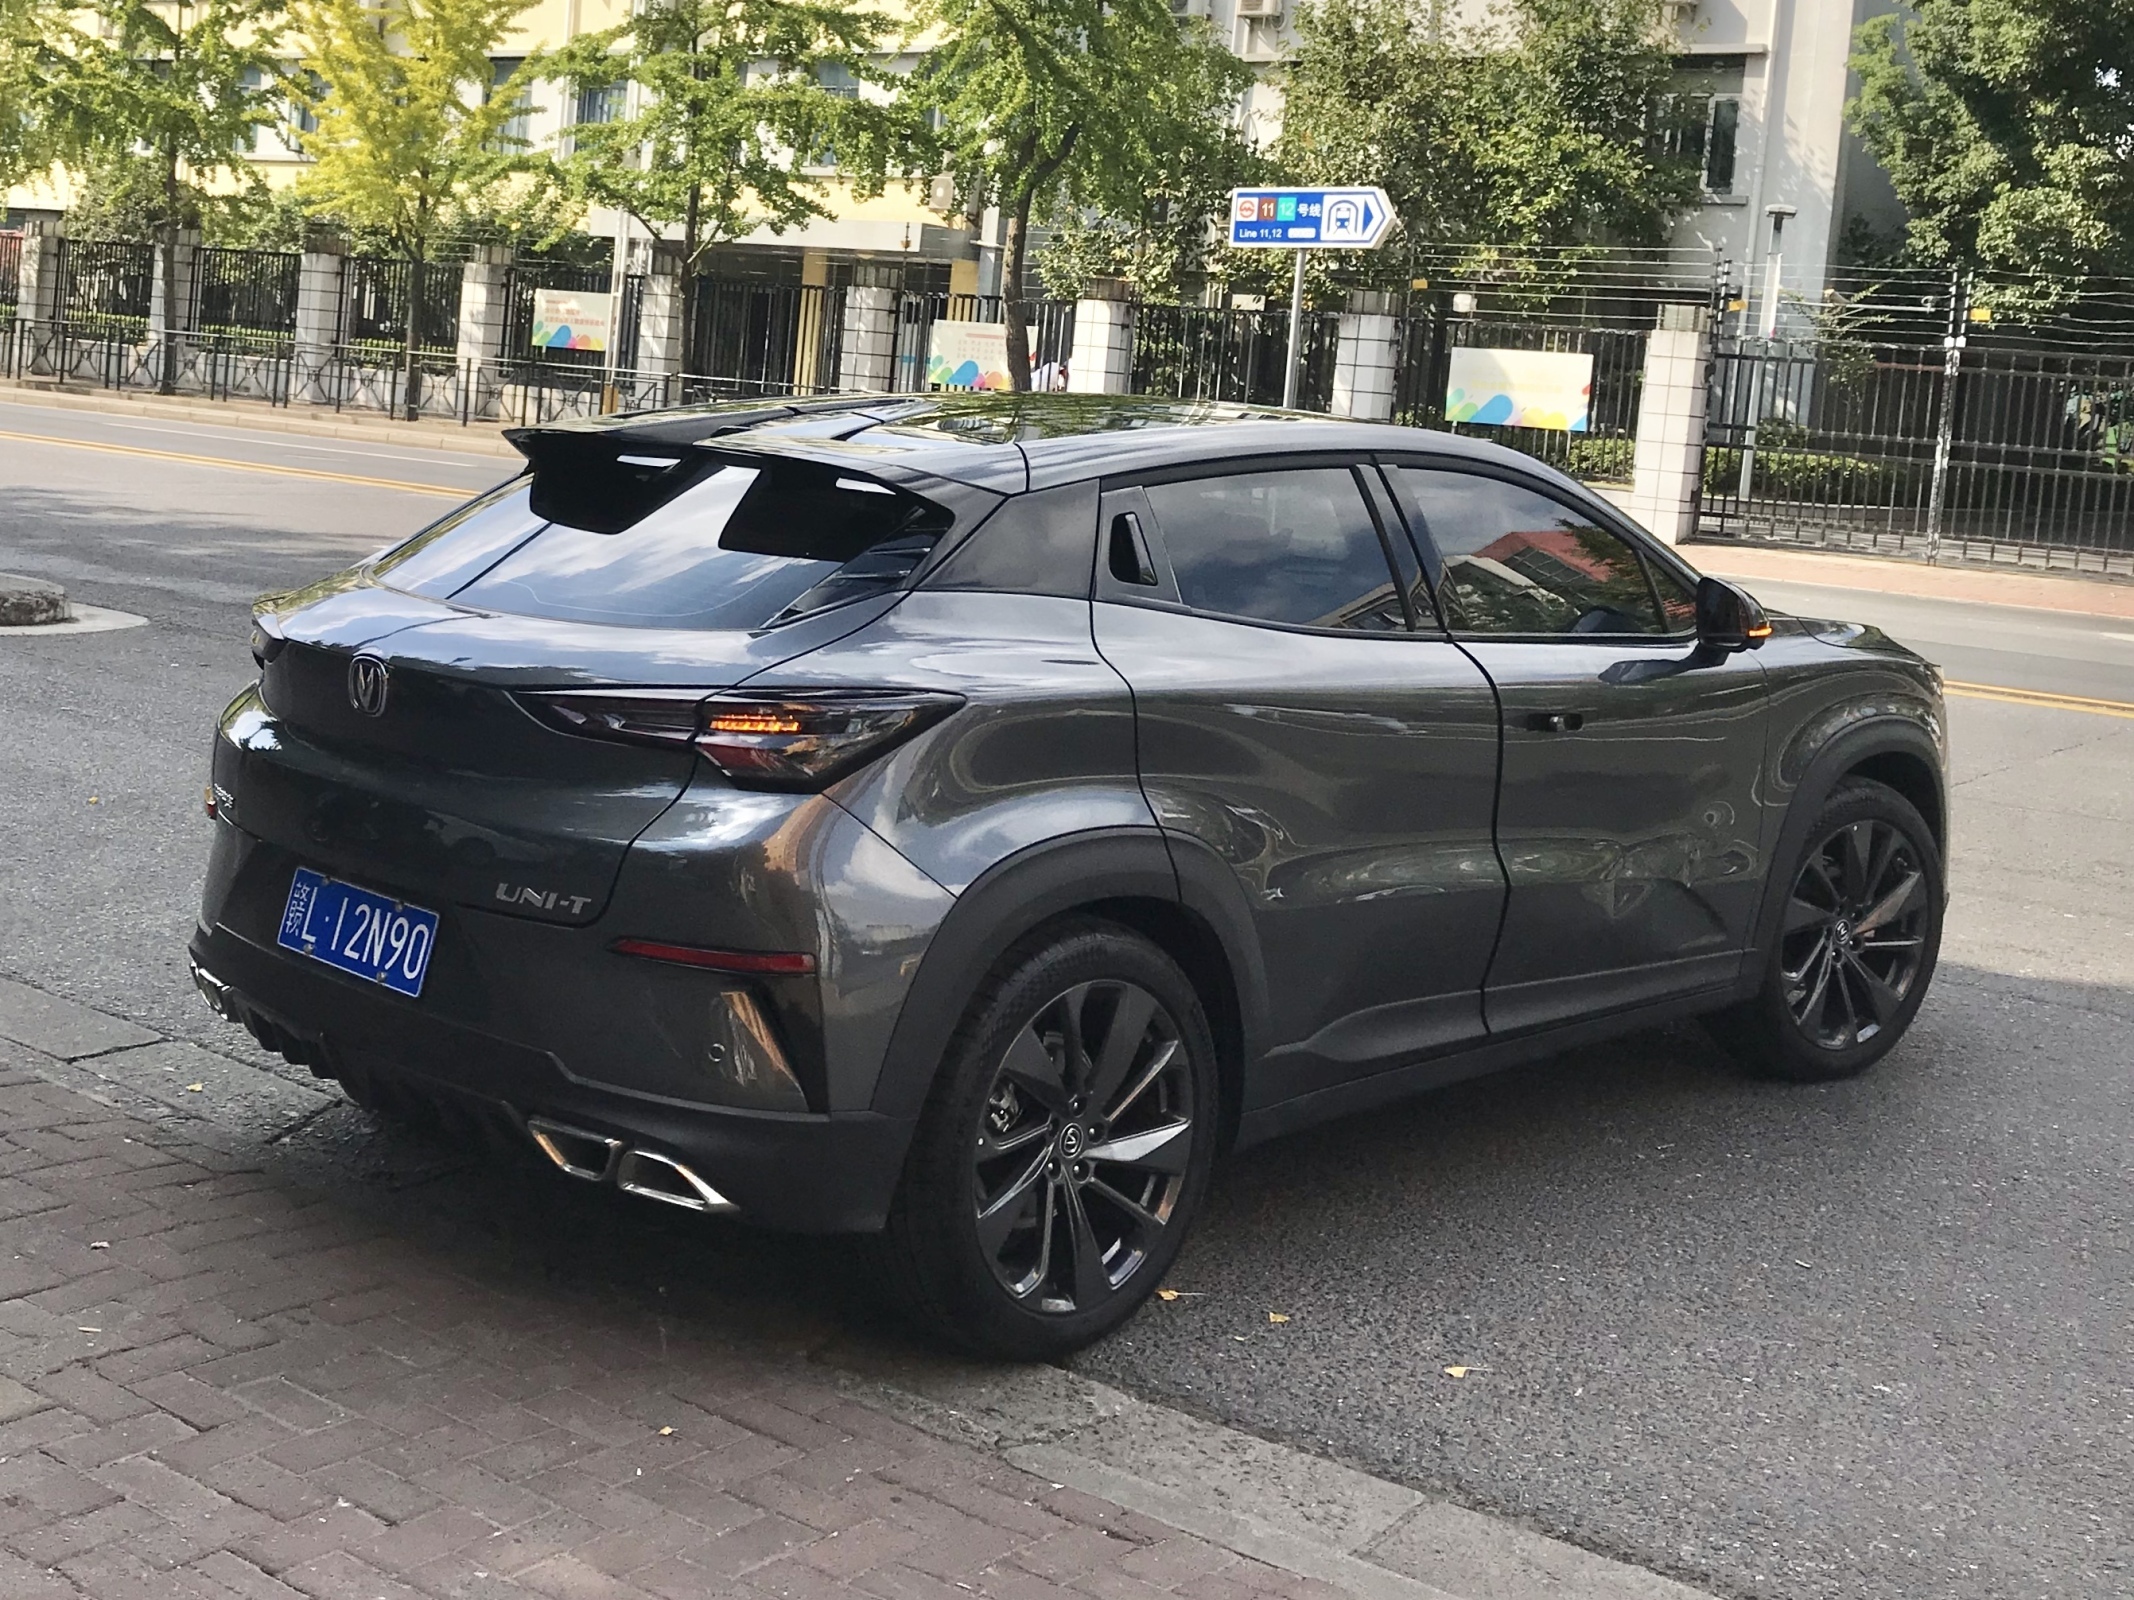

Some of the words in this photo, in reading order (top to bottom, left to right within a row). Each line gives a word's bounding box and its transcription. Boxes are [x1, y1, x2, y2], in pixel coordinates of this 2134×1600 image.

[1262, 203, 1274, 217] 11
[1280, 203, 1294, 216] 12
[1297, 203, 1321, 218] 号线
[1239, 228, 1257, 238] Line
[1260, 228, 1282, 239] 11,12
[496, 882, 592, 914] UNI-T
